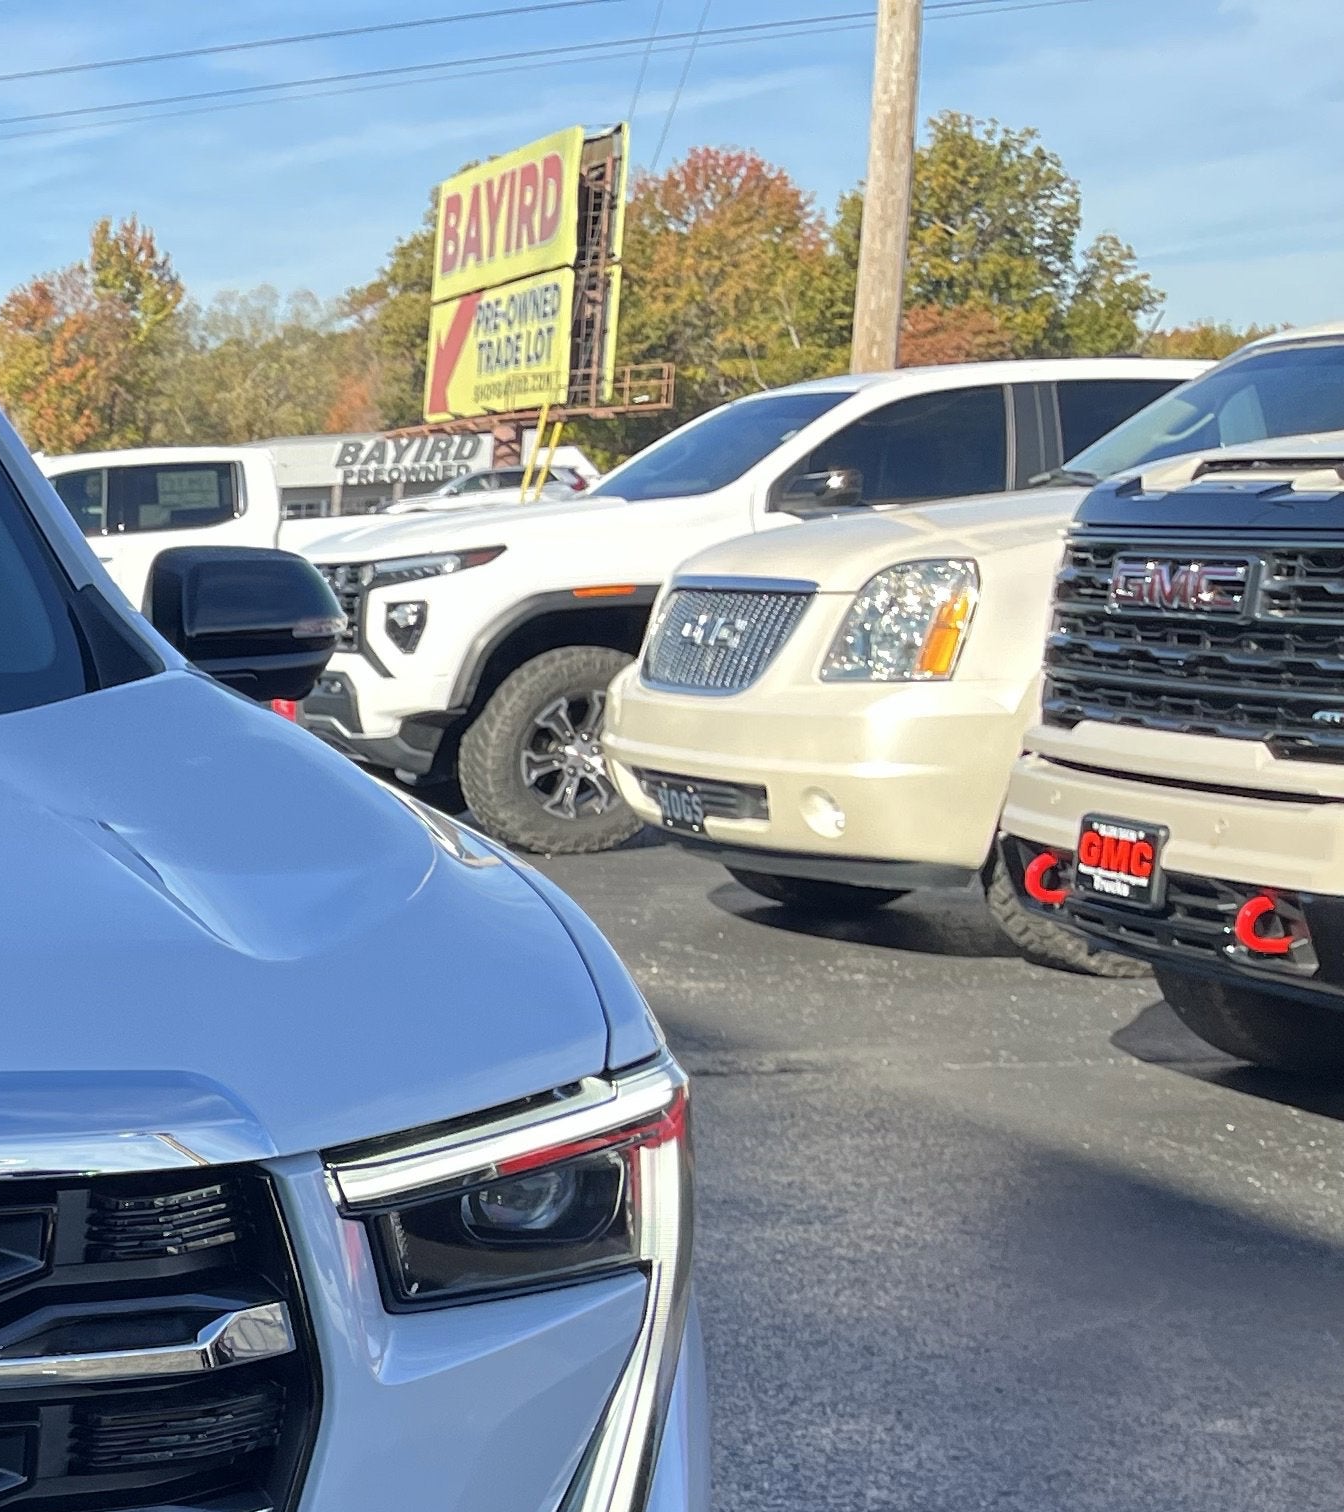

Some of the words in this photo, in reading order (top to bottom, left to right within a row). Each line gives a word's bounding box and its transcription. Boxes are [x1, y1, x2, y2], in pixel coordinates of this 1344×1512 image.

[440, 152, 563, 277] BAYIRD
[474, 282, 560, 335] PRE-OWNED
[476, 333, 521, 377] TRADE
[524, 326, 555, 366] LOT
[336, 433, 480, 467] BAYIRD
[343, 465, 470, 485] PREOWNED
[1110, 560, 1247, 613] GMC
[657, 786, 704, 823] HOGS
[1079, 830, 1153, 877] GMC
